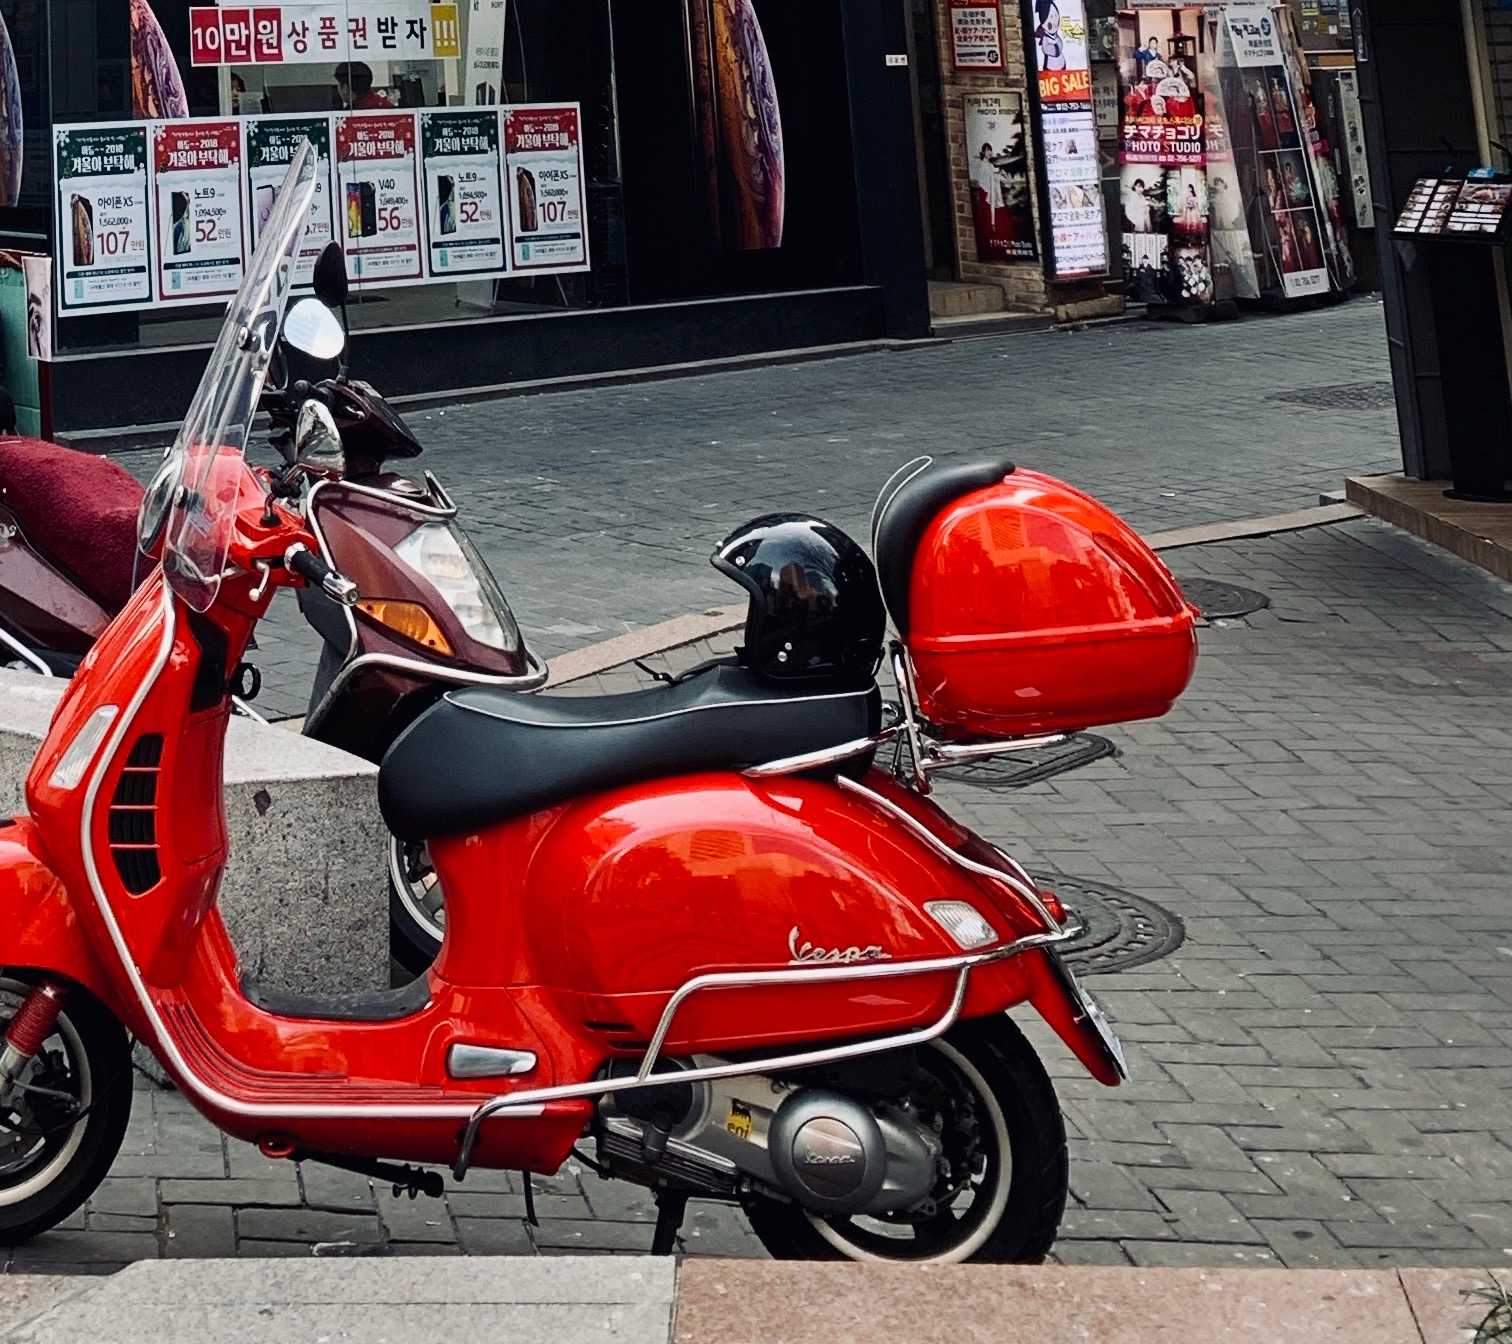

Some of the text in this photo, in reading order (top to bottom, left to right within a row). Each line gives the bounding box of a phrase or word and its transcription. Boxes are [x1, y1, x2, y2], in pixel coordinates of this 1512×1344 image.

[192, 19, 282, 54] 10만원
[1039, 69, 1091, 98] BIG SALE
[1123, 123, 1202, 141] チマチョゴリ
[1124, 141, 1202, 154] PHOTO STUDIO
[71, 154, 137, 174] 겨울아 부탁해
[167, 150, 231, 168] 겨울아 부탁해
[788, 924, 893, 965] Vespa
